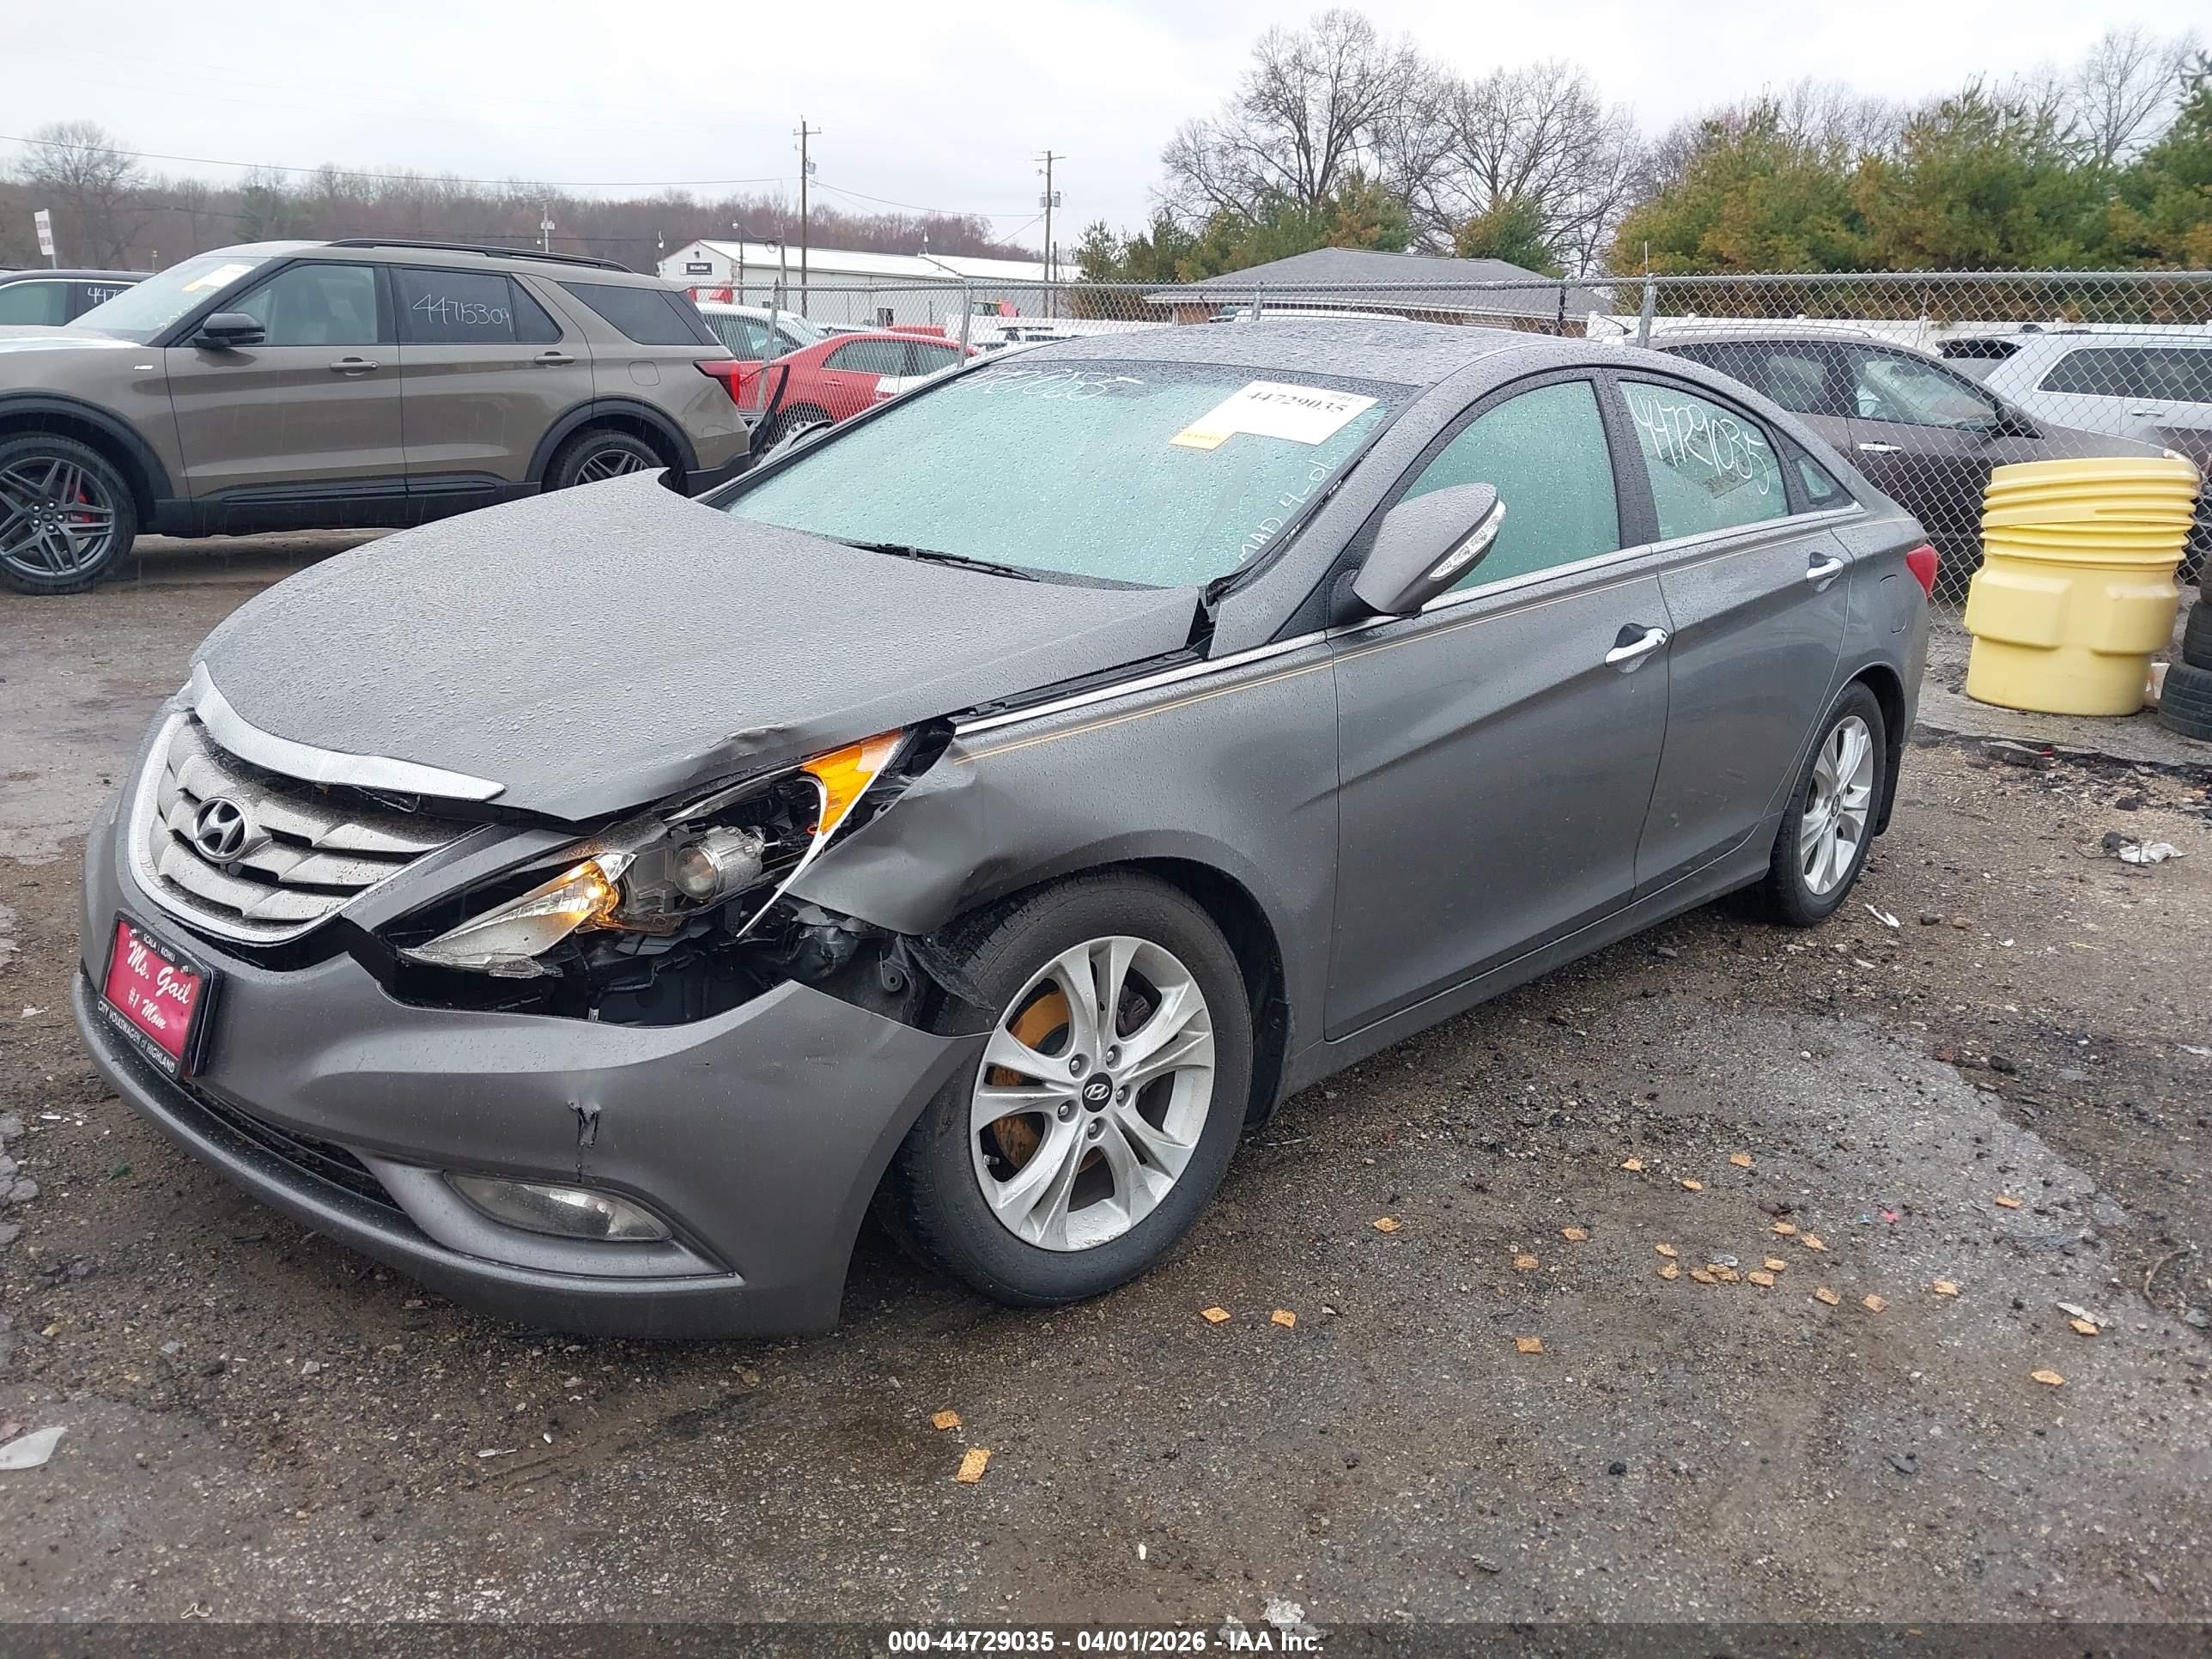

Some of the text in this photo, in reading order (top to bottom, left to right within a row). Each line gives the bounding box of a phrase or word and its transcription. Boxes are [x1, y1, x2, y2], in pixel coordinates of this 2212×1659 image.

[412, 294, 513, 333] 44715309
[1247, 392, 1349, 413] 44729035
[1626, 392, 1770, 495] 44729035
[126, 939, 191, 1005] Ms. Gail
[128, 987, 167, 1030] #1 Mom
[98, 1000, 110, 1016] CITY
[109, 1009, 142, 1045] VOLKSWAGEN
[146, 1041, 175, 1073] HIGHLAND
